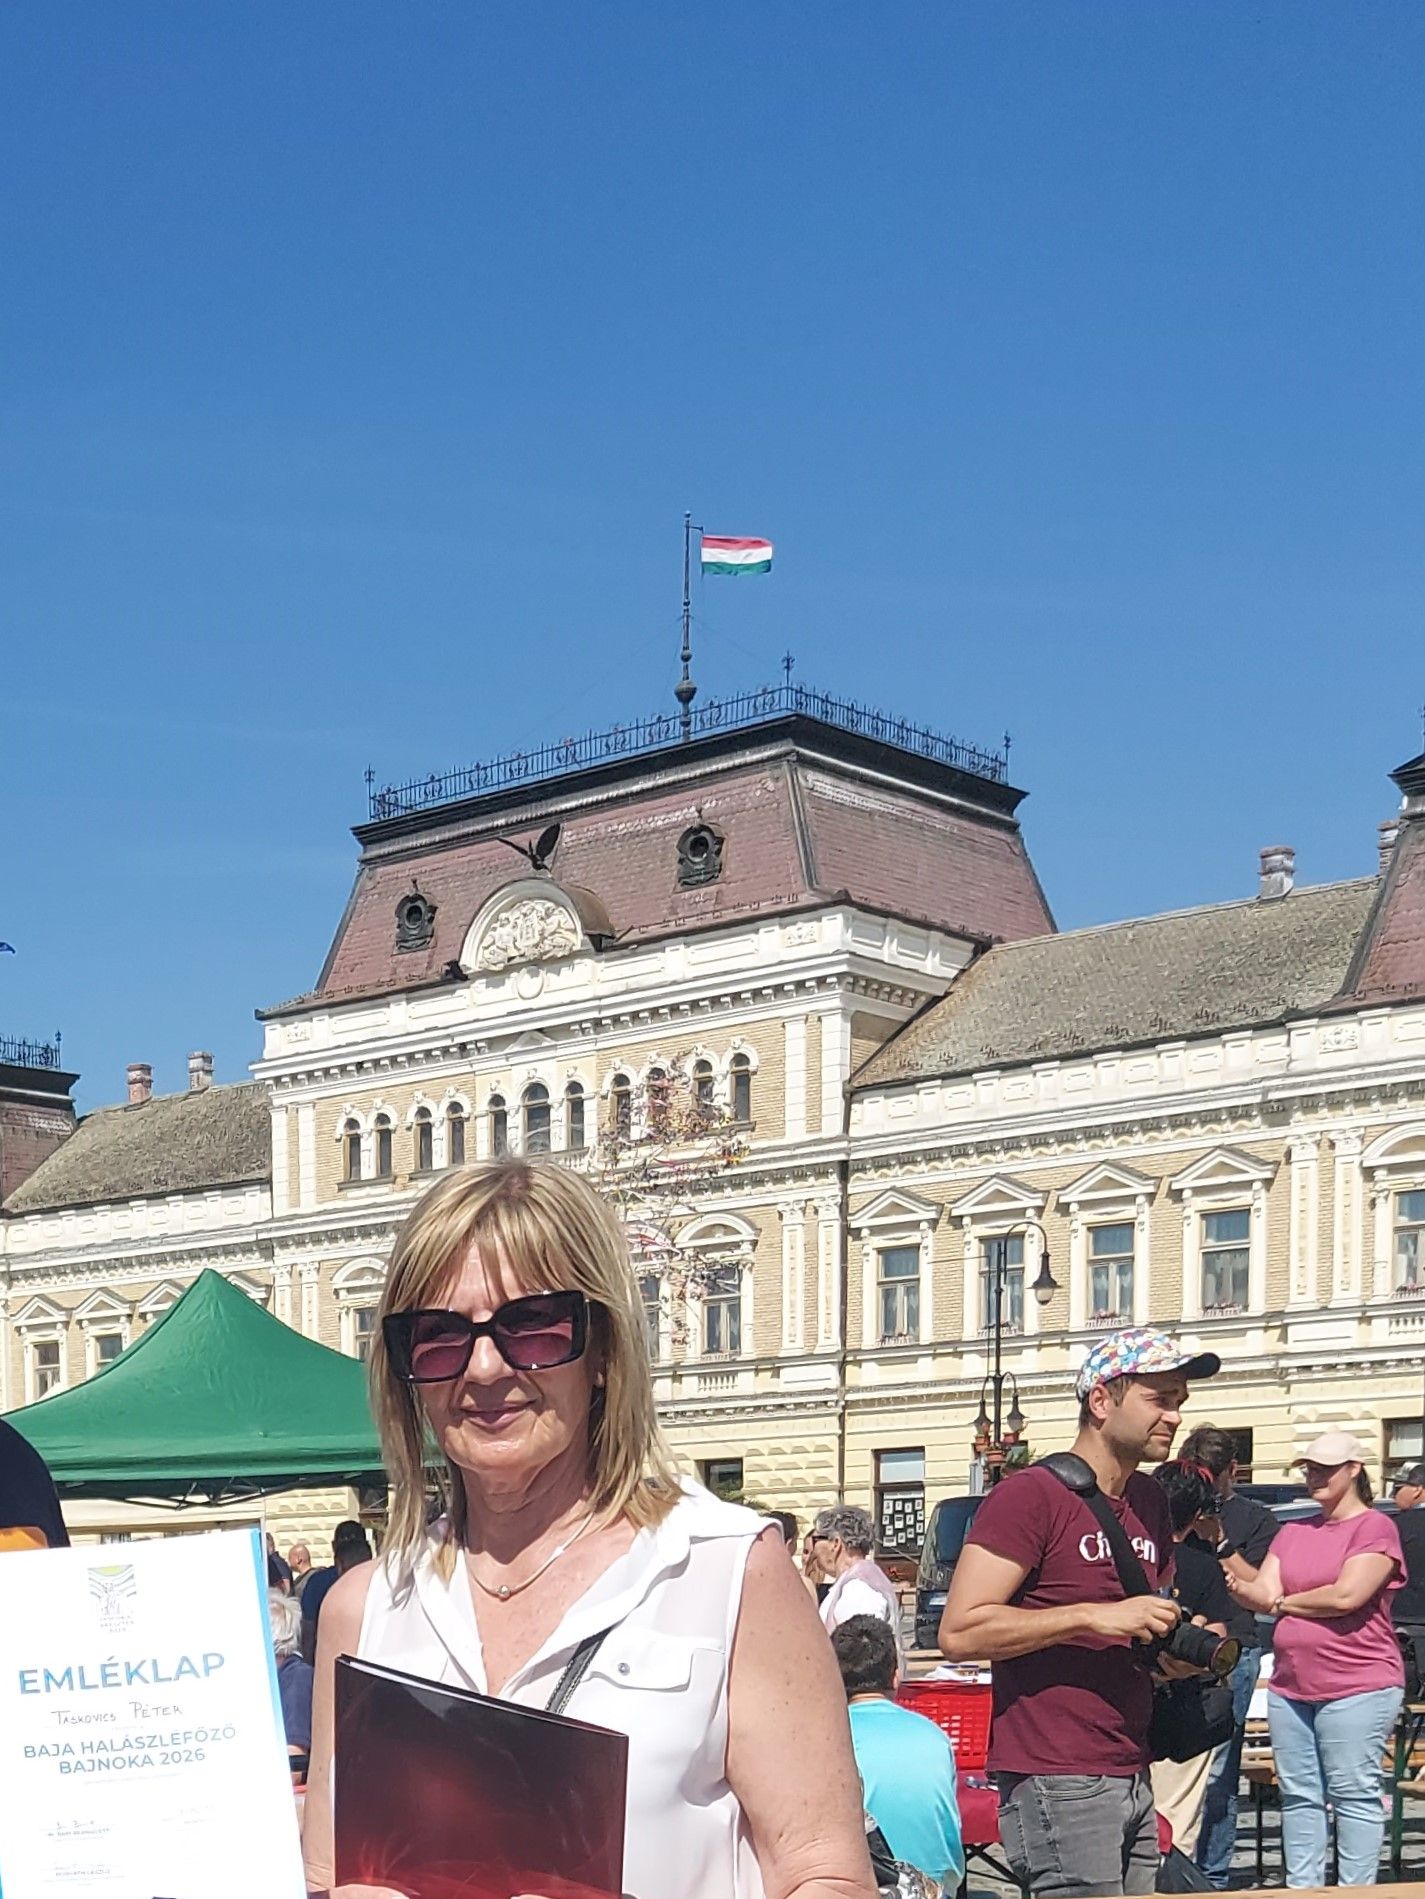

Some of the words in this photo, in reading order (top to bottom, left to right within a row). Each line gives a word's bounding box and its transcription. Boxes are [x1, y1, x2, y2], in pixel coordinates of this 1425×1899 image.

[1079, 1531, 1155, 1563] Chen
[18, 1652, 225, 1695] EMLÉKLAP
[23, 1743, 76, 1759] BAJA
[58, 1754, 155, 1775] BAJNOKA
[159, 1748, 206, 1766] 2026
